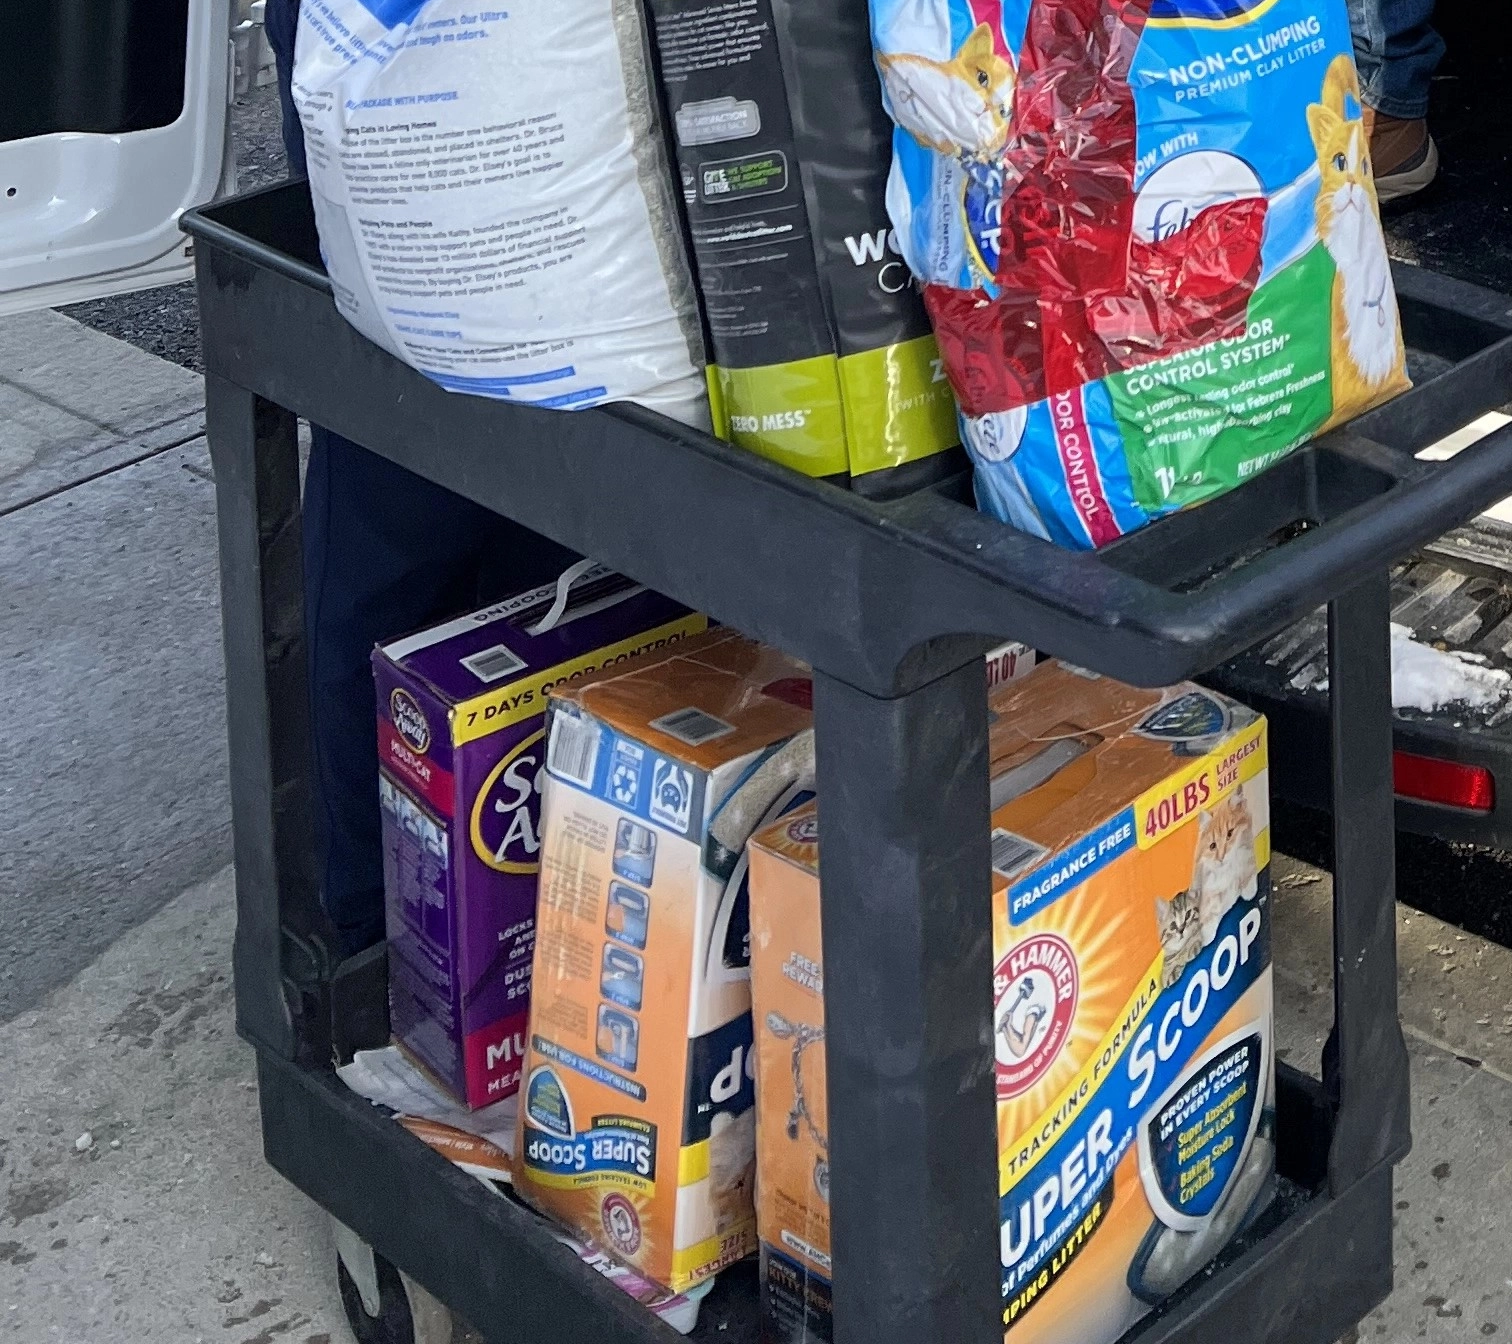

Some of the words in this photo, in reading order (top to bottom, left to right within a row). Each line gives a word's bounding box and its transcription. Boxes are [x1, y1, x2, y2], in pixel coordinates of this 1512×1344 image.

[1168, 15, 1321, 86] NON-CLUMPING
[1175, 69, 1253, 103] PREMIUM
[1256, 53, 1285, 78] CLAY
[1287, 37, 1327, 65] LITTER
[1136, 148, 1158, 176] OW
[1159, 131, 1199, 158] WITH
[1126, 362, 1218, 396] CONTROL
[1231, 379, 1256, 394] odor
[1247, 389, 1284, 409] Febreze
[1286, 370, 1326, 395] Freshness
[730, 415, 759, 432] ZERO
[762, 409, 805, 430] MESS
[1054, 389, 1074, 430] DOR
[1237, 459, 1254, 479] NET
[474, 585, 558, 622] COOPING
[466, 711, 478, 727] 7
[483, 689, 534, 720] DAYS
[1144, 771, 1210, 840] 40LBS
[1215, 734, 1262, 778] LARGEST
[1216, 767, 1240, 793] SIZE
[494, 806, 543, 863] A
[1012, 846, 1098, 916] FRAGRANCE
[1099, 822, 1133, 856] FREE
[498, 918, 534, 942] LOCKS
[508, 947, 527, 960] ON
[993, 974, 1010, 997] &
[1009, 943, 1074, 1004] HAMMER
[558, 1050, 577, 1066] FOR
[577, 1058, 640, 1097] INSTRUCTIONS
[1007, 1081, 1089, 1177] TRACKING
[1093, 977, 1157, 1081] FORMULA
[999, 1108, 1114, 1269] UPER
[1127, 906, 1262, 1110] SCOOP
[1160, 1075, 1207, 1127] PROVEN
[1208, 1045, 1249, 1084] POWER
[1160, 1123, 1174, 1142] IN
[1175, 1089, 1211, 1127] EVERY
[1212, 1060, 1250, 1095] SCOOP
[1177, 1119, 1204, 1149] Super
[1204, 1081, 1248, 1126] Absorbent
[528, 1141, 587, 1171] SCOOP
[591, 1140, 651, 1175] SUPER
[1178, 1127, 1215, 1166] Moisture
[1215, 1109, 1236, 1135] Lock
[1180, 1155, 1212, 1188] Baking
[1211, 1135, 1235, 1162] Soda
[1179, 1167, 1216, 1204] Crystals
[1001, 1273, 1016, 1298] of
[1016, 1206, 1080, 1283] Perfumes
[1080, 1165, 1105, 1209] and
[1104, 1125, 1133, 1173] Dyes
[1002, 1268, 1049, 1325] PING
[1052, 1200, 1101, 1275] LITTER
